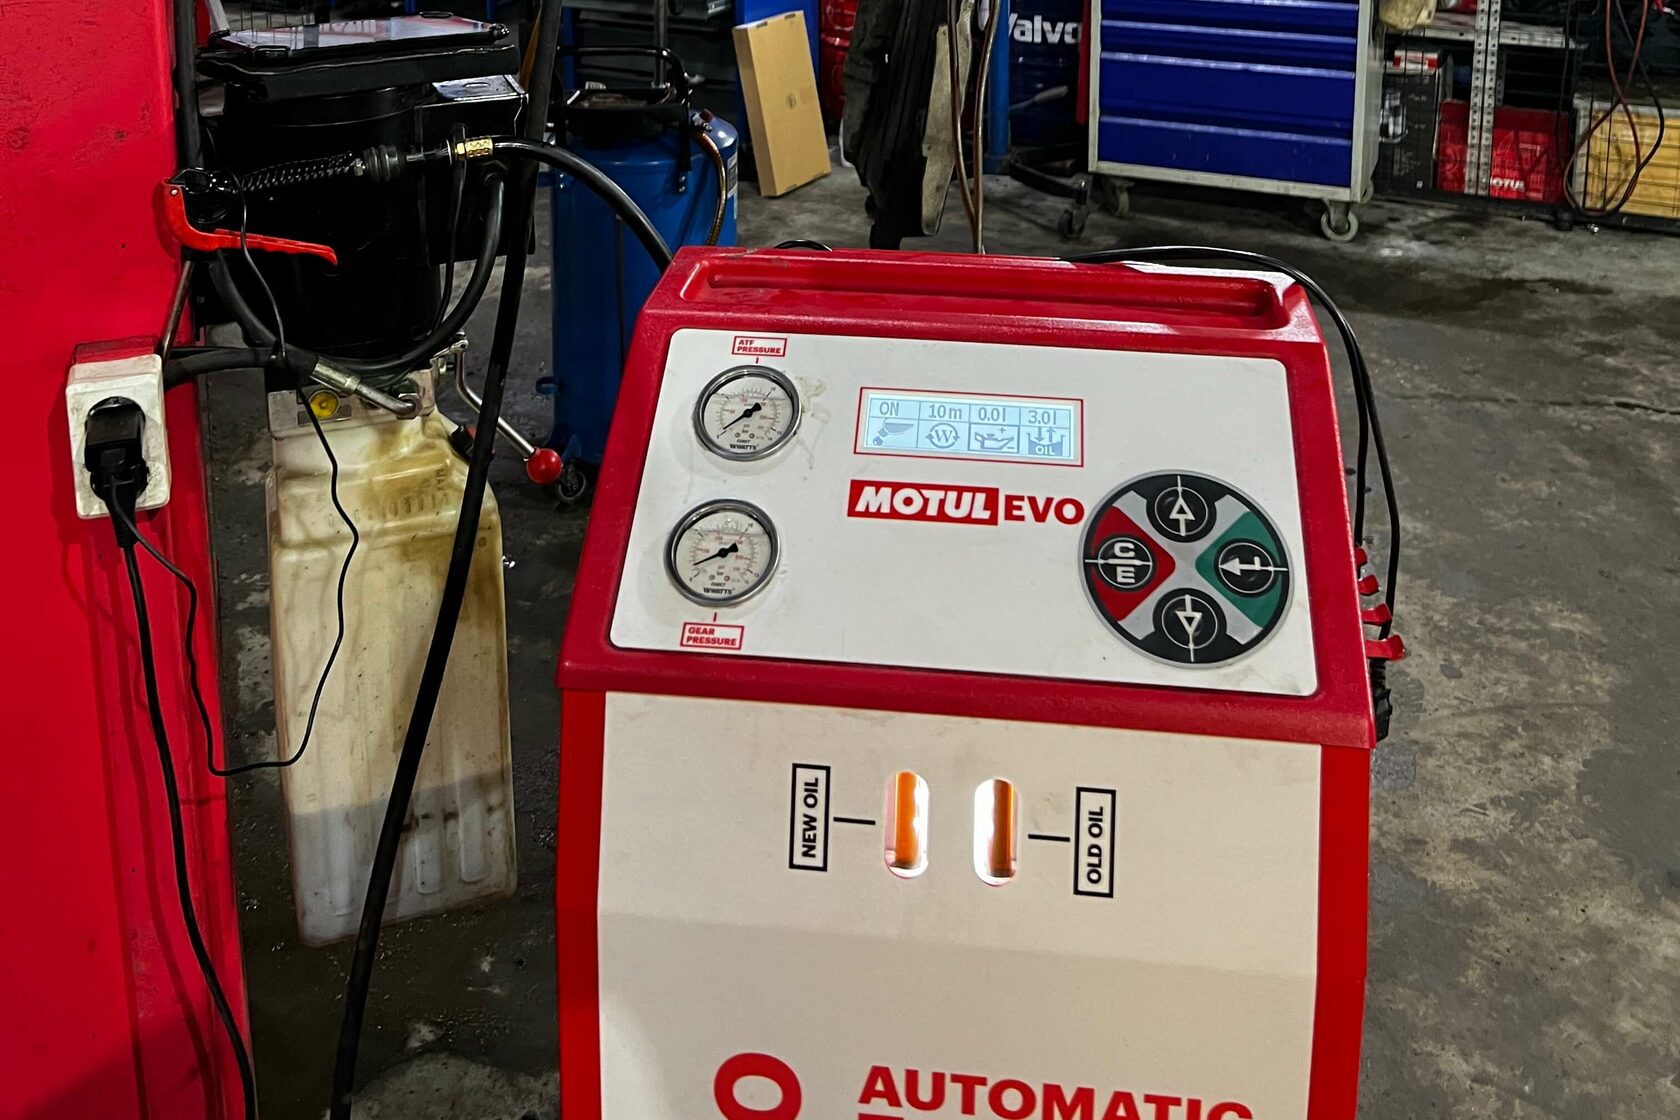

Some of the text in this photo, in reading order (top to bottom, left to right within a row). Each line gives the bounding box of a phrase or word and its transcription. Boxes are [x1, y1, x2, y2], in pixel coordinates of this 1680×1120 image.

[737, 346, 781, 354] PRESSURE
[879, 401, 900, 417] ON
[1035, 445, 1055, 455] OIL
[855, 486, 1084, 525] MOTUL EVO
[688, 626, 715, 635] GEAR
[686, 635, 737, 646] PRESSURE
[802, 777, 819, 858] NEW OIL
[1087, 806, 1103, 884] OLD OIL
